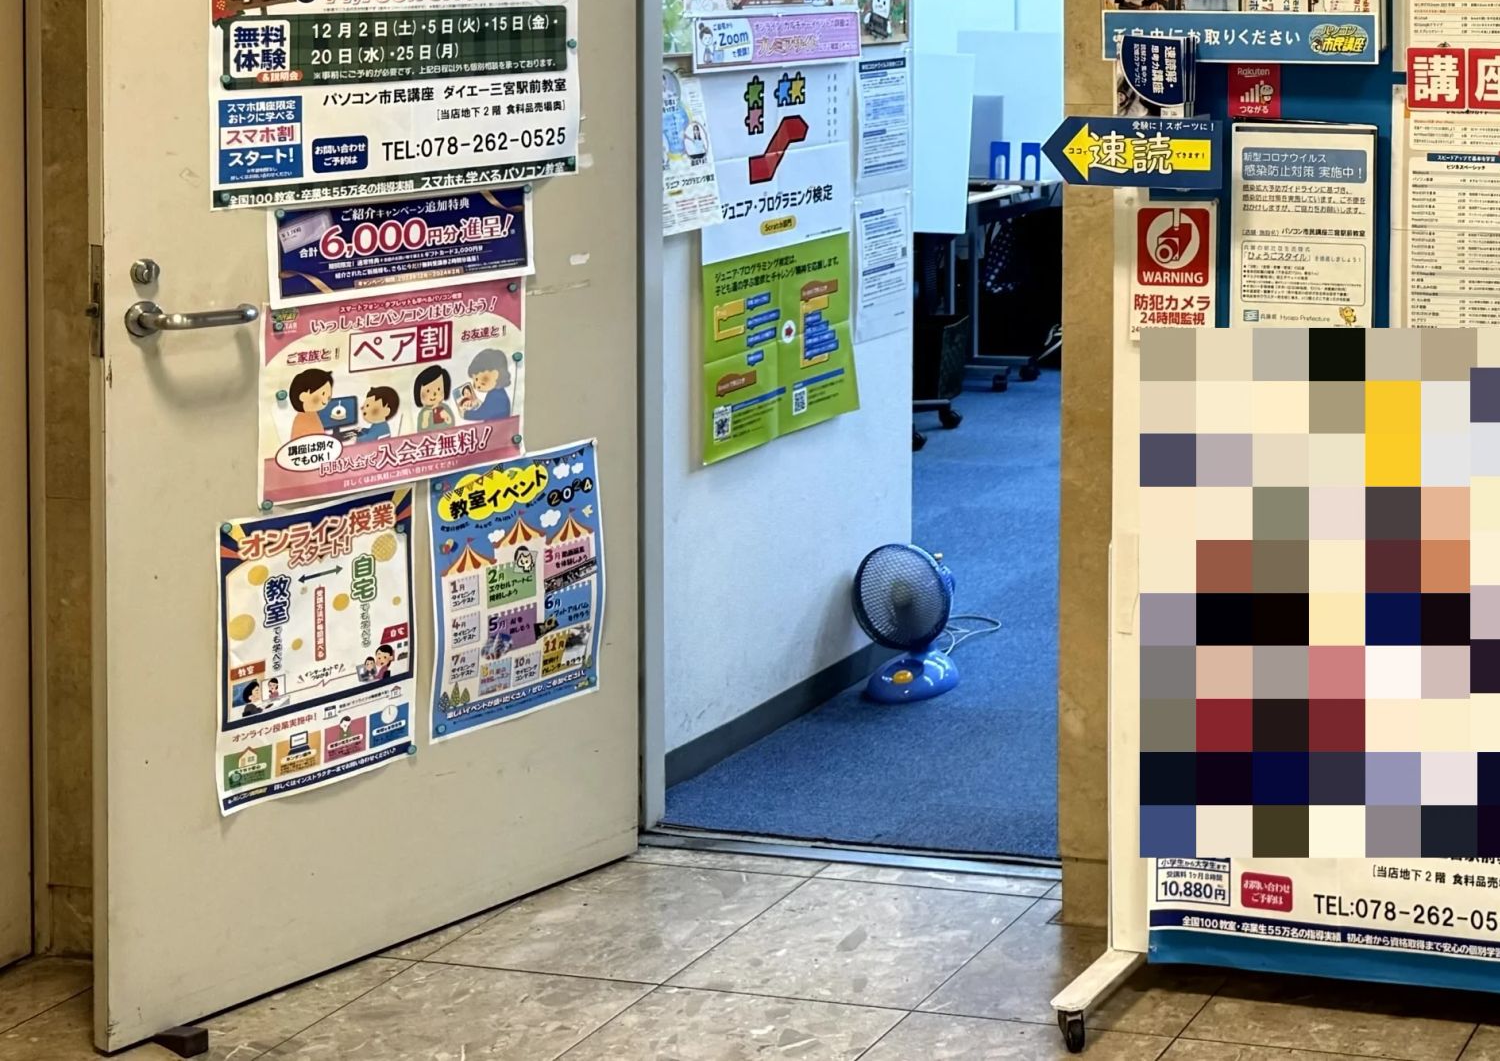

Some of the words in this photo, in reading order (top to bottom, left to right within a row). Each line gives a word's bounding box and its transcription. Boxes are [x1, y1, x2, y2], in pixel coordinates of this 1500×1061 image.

[233, 24, 287, 48] 無料
[718, 31, 750, 47] Zoom
[233, 48, 287, 72] 体験
[1237, 67, 1270, 78] Rakuten
[322, 86, 434, 107] パソコン市民講座
[443, 78, 567, 100] ダイエー三宮駅前教室
[227, 99, 296, 114] スマホ講座限定
[1238, 104, 1269, 114] つながる
[228, 110, 295, 125] おトクに学べる
[226, 125, 295, 145] スマホ割
[381, 126, 567, 162] TEL:078-262-0525
[228, 147, 295, 168] スタート!
[314, 143, 366, 156] お問い合わせ
[1088, 130, 1173, 176] 速読
[1243, 151, 1327, 163] 新型コロナウイルス
[323, 155, 358, 167] ご予約は
[1243, 164, 1315, 178] 感染防止対策
[420, 161, 566, 190] スマホも学べるパソコン教室
[340, 196, 471, 223] ご紹介キャンペーン追加特典
[721, 184, 834, 220] ジュニア・プログラミング検定
[299, 247, 318, 260] 合計
[1142, 270, 1204, 284] WARNING
[1134, 294, 1211, 311] 防犯カメラ
[309, 297, 498, 335] いっしょにパソコンはじめよう!
[1140, 311, 1206, 325] 24時間監視
[352, 323, 451, 363] ペア割
[288, 440, 335, 457] 講座は別々
[449, 469, 548, 520] 教室イベント
[240, 503, 396, 560] オンライン授業
[351, 555, 377, 602] 自宅
[487, 568, 505, 585] 2月
[264, 575, 291, 628] 教室
[544, 594, 561, 610] 6月
[1161, 880, 1226, 901] 10,880円
